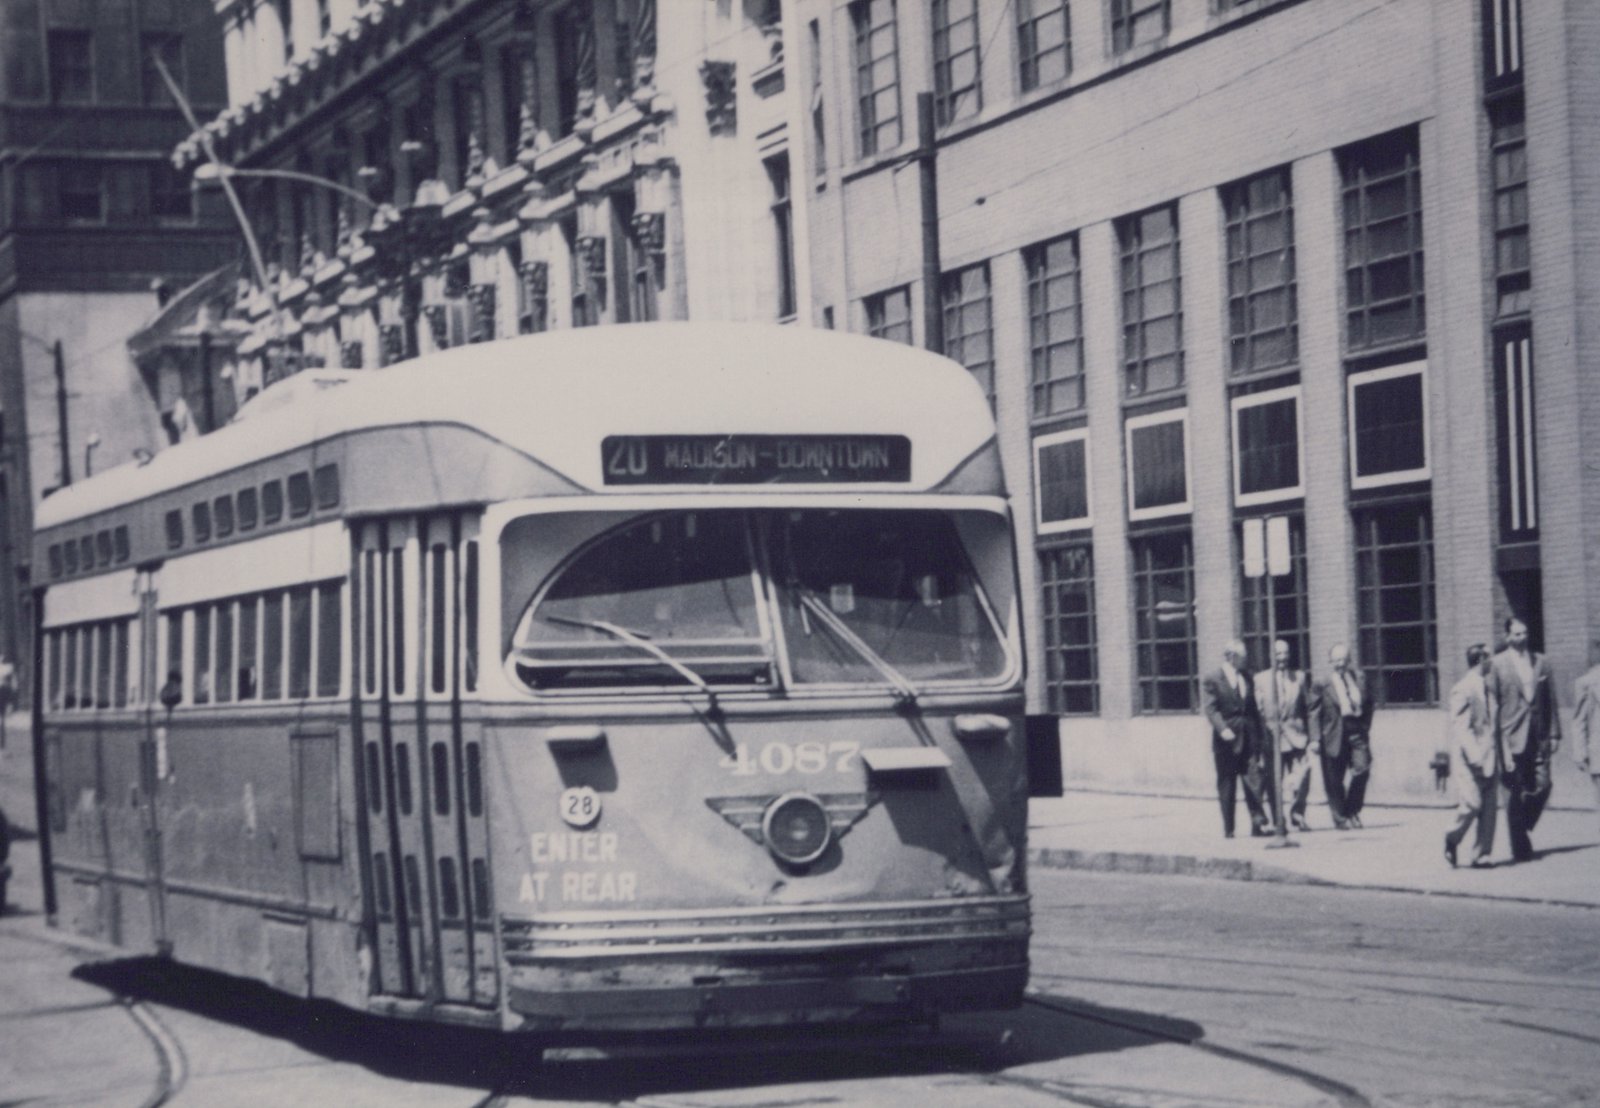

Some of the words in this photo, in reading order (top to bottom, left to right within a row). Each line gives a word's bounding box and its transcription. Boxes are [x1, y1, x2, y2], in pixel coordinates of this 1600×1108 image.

[608, 440, 648, 475] 20
[718, 740, 860, 775] 4087
[568, 795, 593, 816] 28
[530, 832, 619, 863] ENTER
[519, 872, 551, 902] AT
[561, 871, 637, 901] REAR
